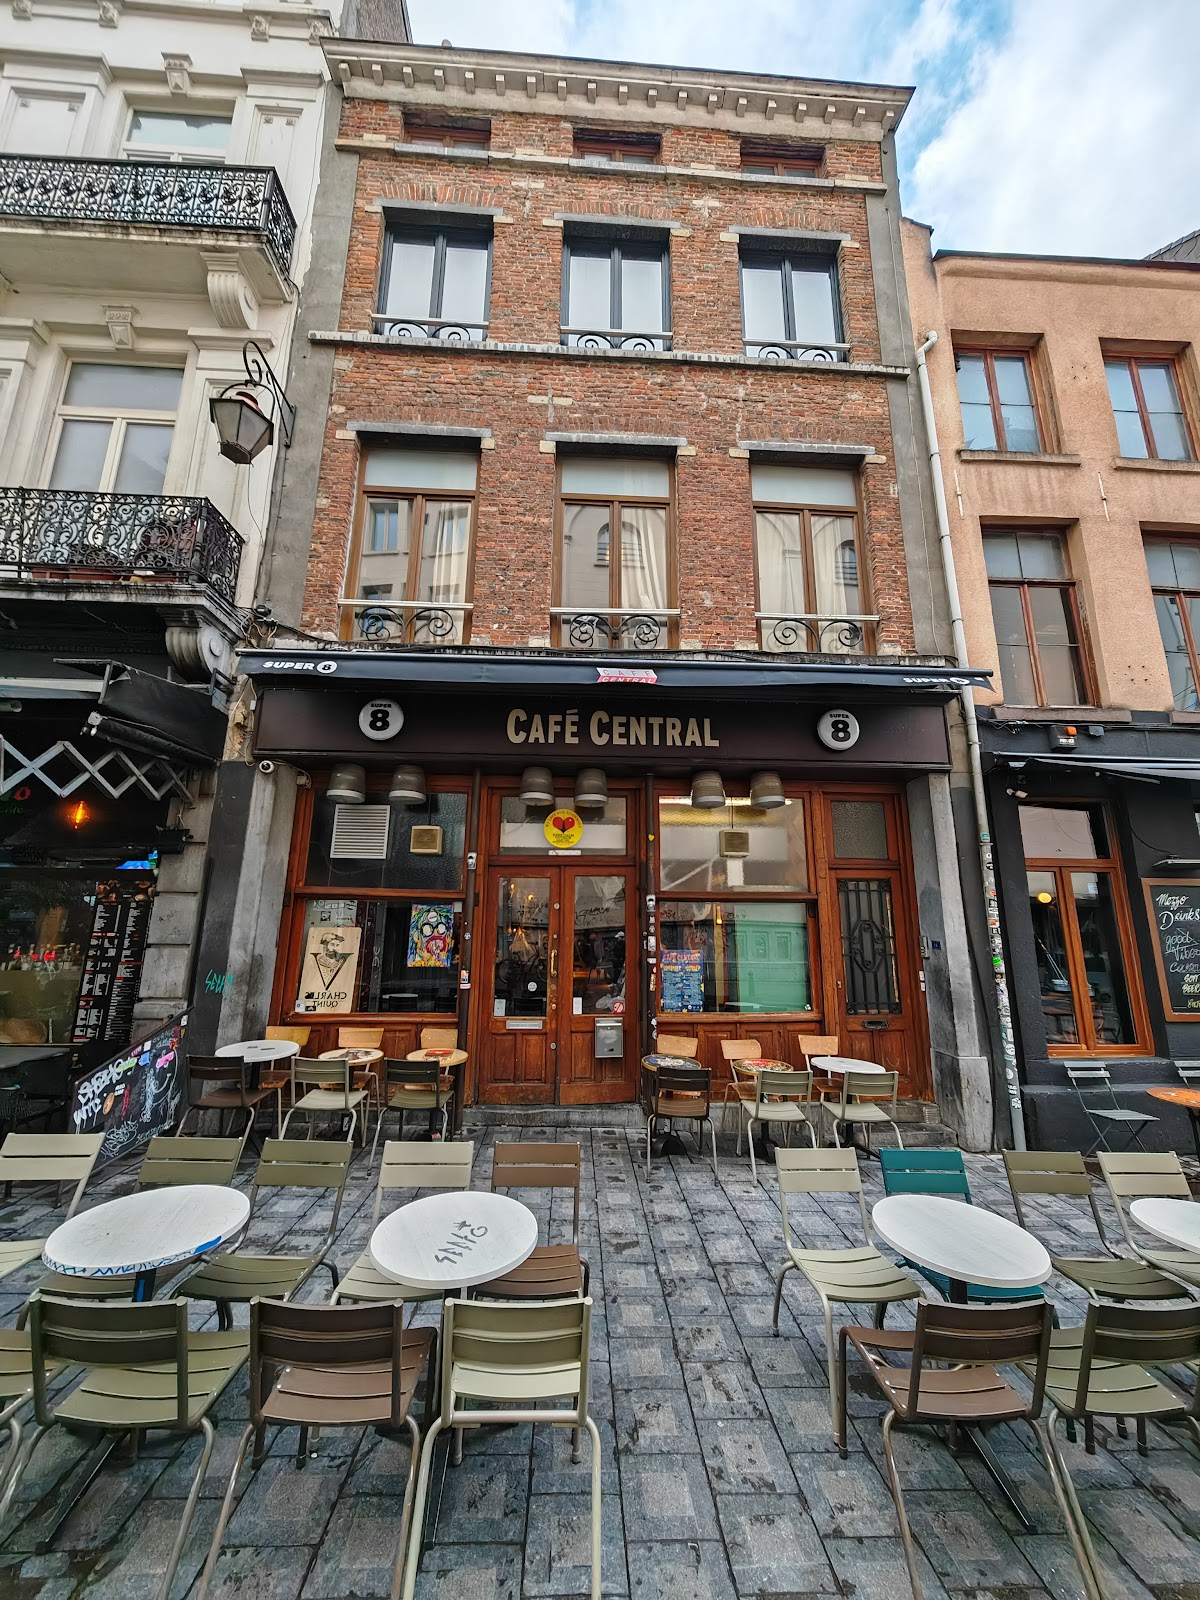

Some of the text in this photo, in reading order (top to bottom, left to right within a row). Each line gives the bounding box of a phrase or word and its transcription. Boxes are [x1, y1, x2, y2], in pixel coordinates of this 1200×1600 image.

[262, 661, 315, 670] SUPER
[602, 676, 653, 684] CENTRAL
[369, 709, 390, 731] 8
[506, 708, 720, 747] CAFÉ CENTRAL
[831, 719, 851, 743] 8
[1156, 893, 1189, 910] Mezzo
